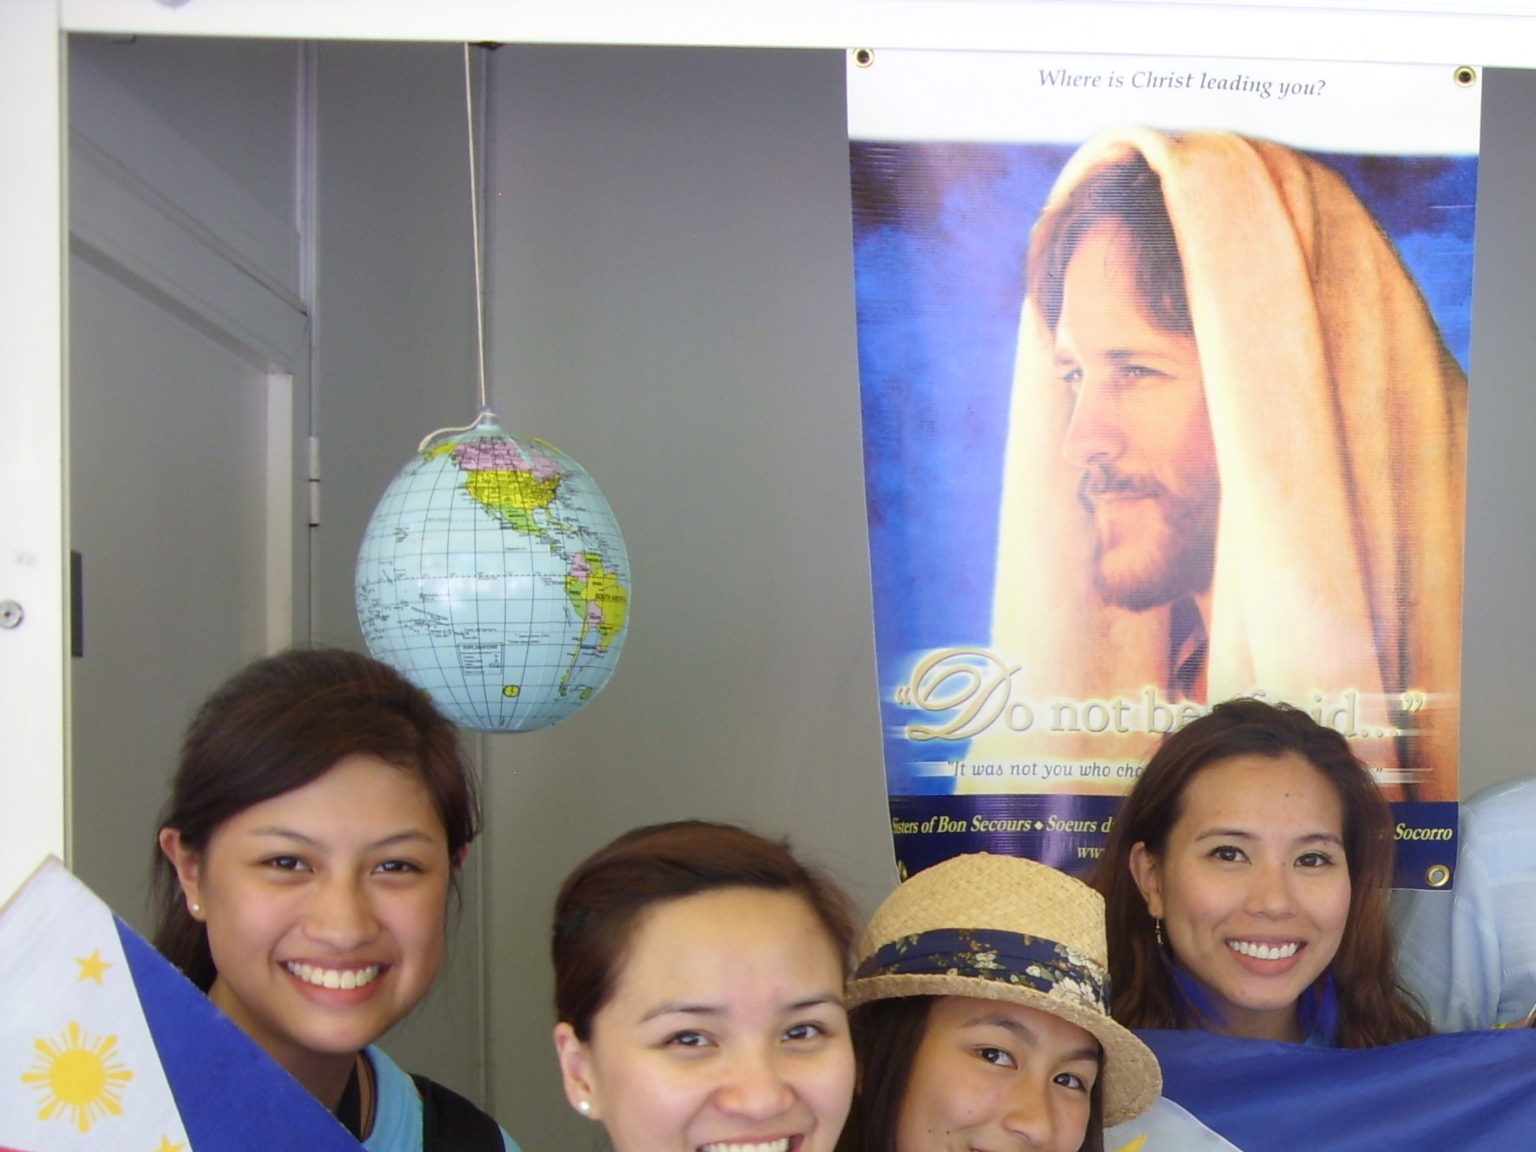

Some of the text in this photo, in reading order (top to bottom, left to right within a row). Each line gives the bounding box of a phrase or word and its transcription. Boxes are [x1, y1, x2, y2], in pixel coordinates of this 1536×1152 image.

[1039, 69, 1326, 100] Where is Christ leading you?
[1051, 700, 1131, 733] not
[1145, 688, 1204, 733] be
[971, 764, 1004, 777] was
[1010, 762, 1038, 777] not
[1042, 764, 1073, 780] you
[1079, 762, 1111, 777] who
[1116, 763, 1144, 778] cho
[920, 816, 937, 834] of
[938, 815, 967, 833] Bon
[970, 814, 1033, 832] Secours
[1046, 815, 1098, 832] Soeurs
[1394, 823, 1453, 840] Socorro
